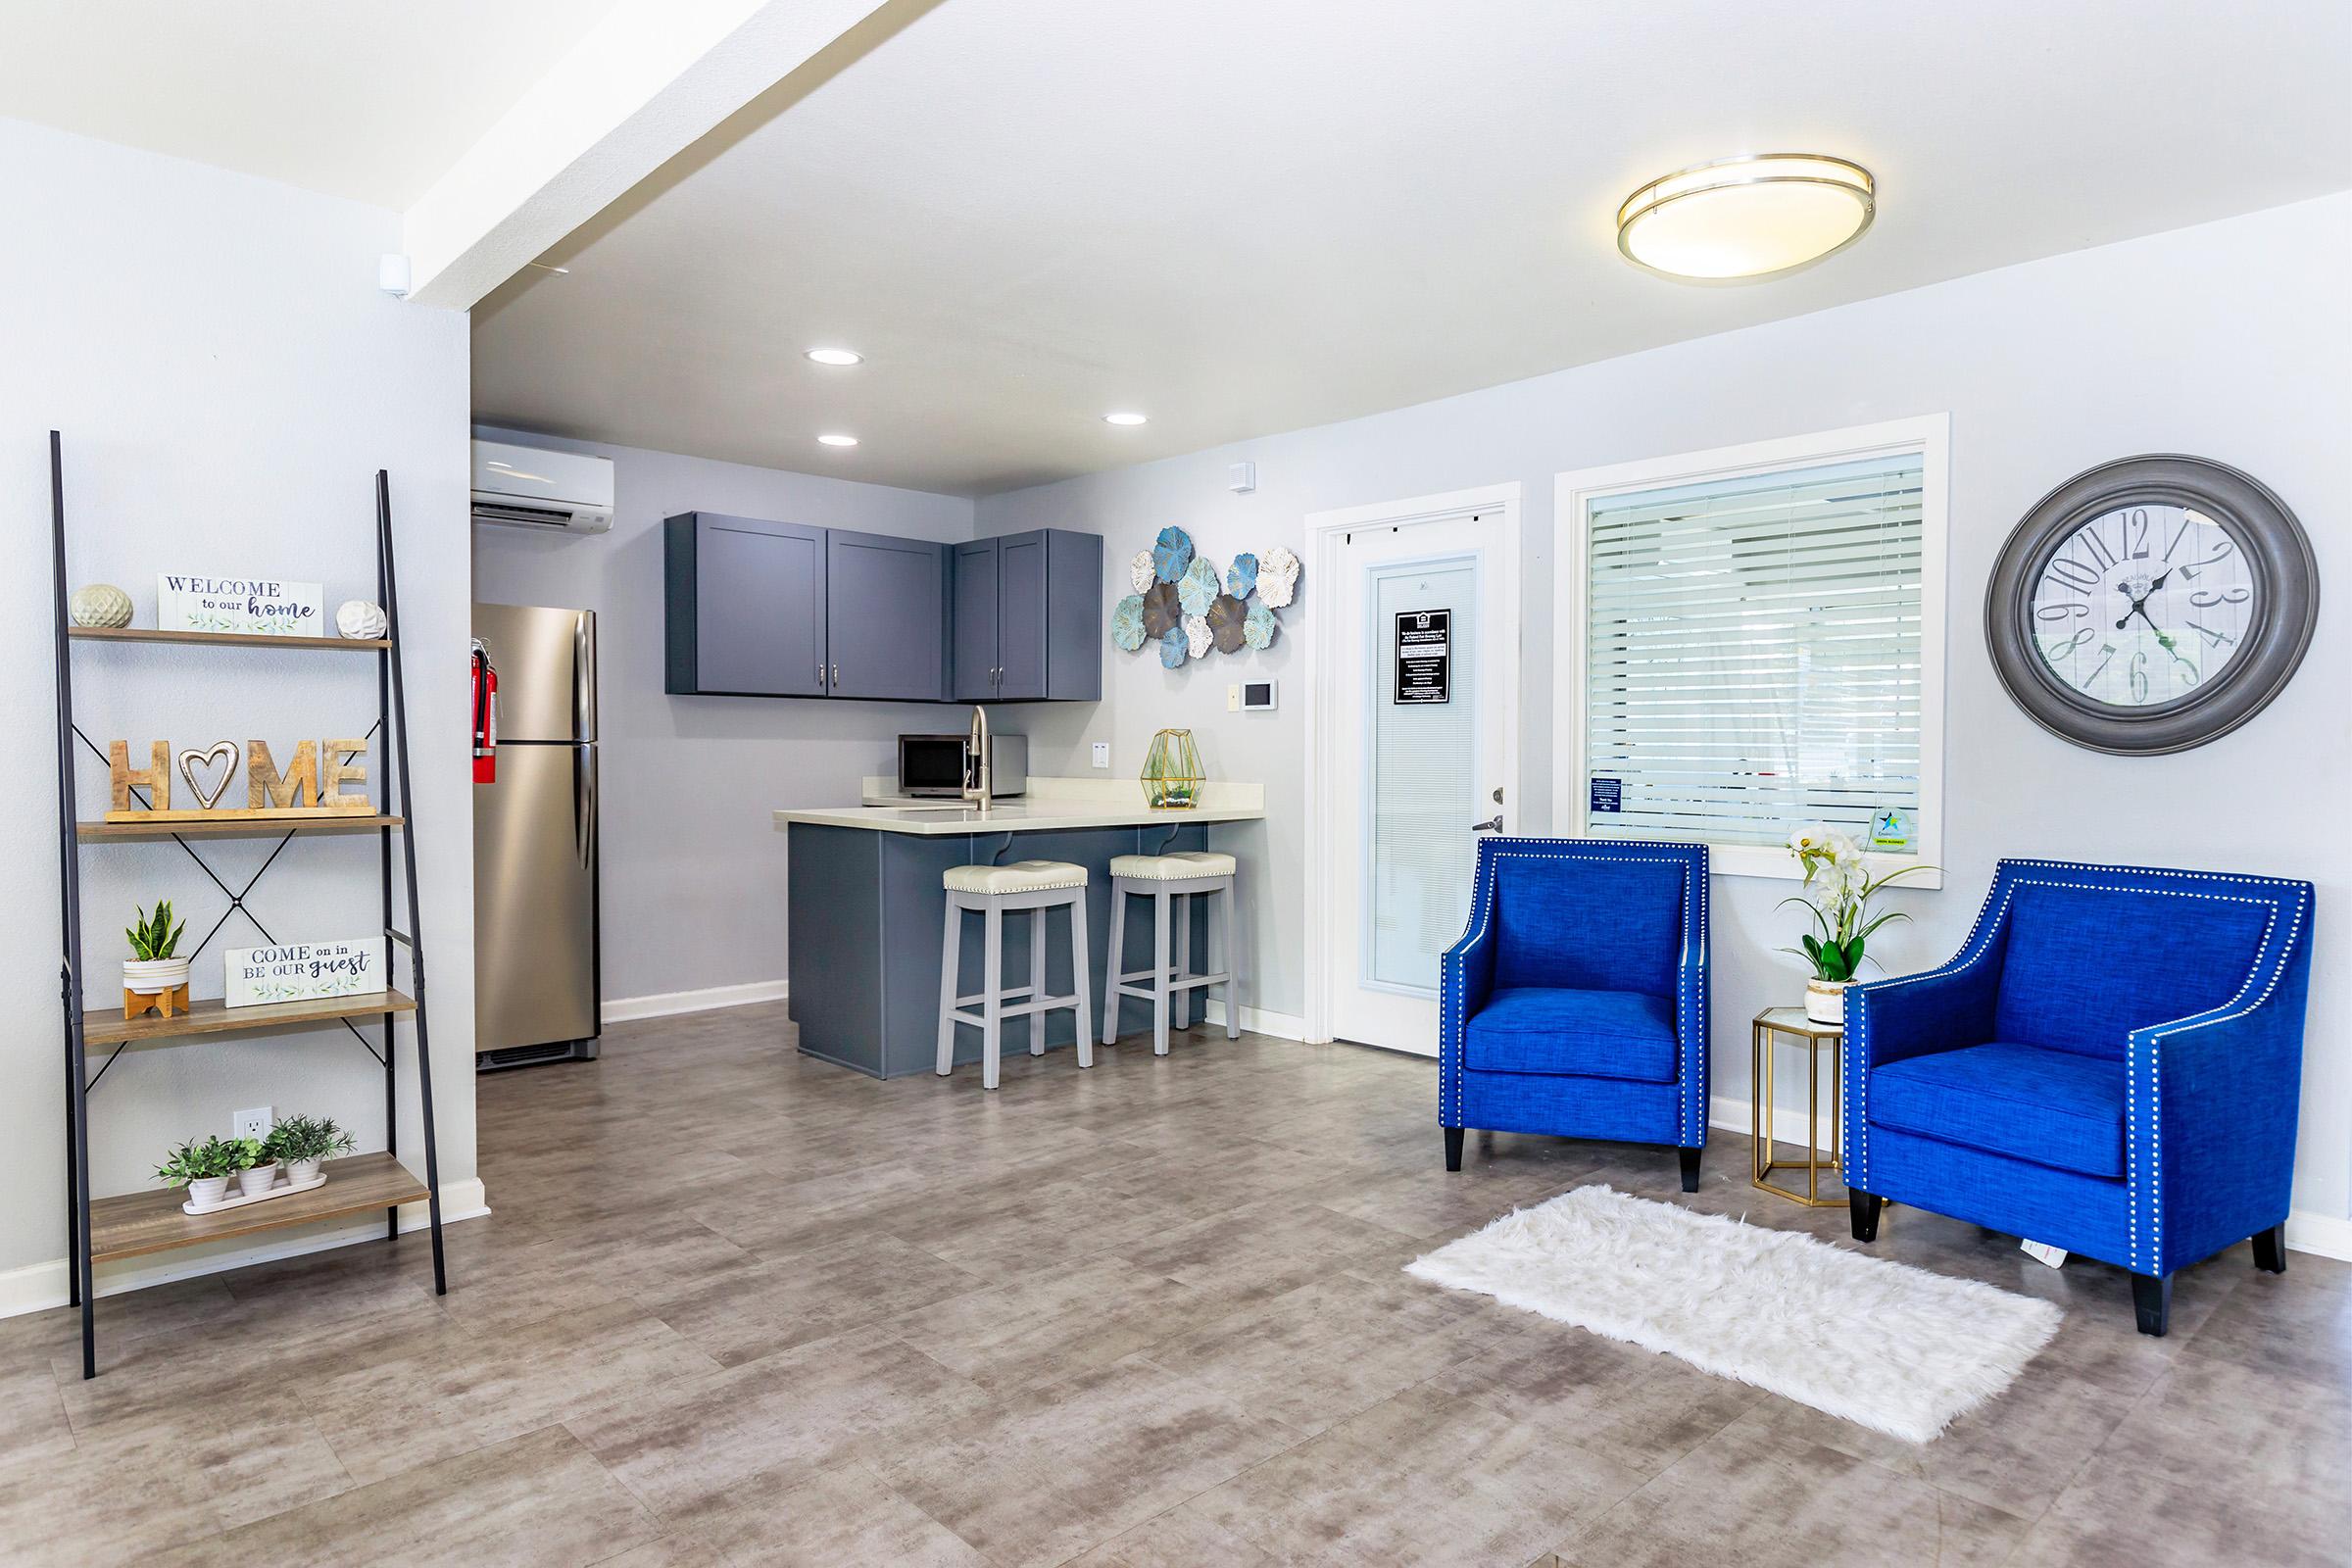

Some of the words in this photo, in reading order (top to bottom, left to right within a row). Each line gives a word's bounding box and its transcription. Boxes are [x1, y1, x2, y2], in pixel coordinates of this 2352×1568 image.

[2077, 526, 2119, 572] 11
[2121, 509, 2150, 561] 12
[2179, 541, 2234, 581] 2
[166, 575, 281, 598] WELCOME
[2045, 558, 2100, 597] 10
[202, 599, 215, 610] to
[219, 600, 242, 611] our
[248, 596, 316, 618] home
[2036, 603, 2089, 621] 9
[2189, 588, 2250, 609] 3
[2047, 627, 2095, 662] 8
[2184, 620, 2236, 650] 4
[2082, 643, 2117, 689] 7
[2130, 651, 2148, 704] 6
[243, 966, 266, 979] BE
[272, 963, 306, 977] OUR
[309, 950, 370, 978] guest
[252, 946, 311, 964] COME
[316, 948, 331, 956] on
[336, 945, 348, 955] in
